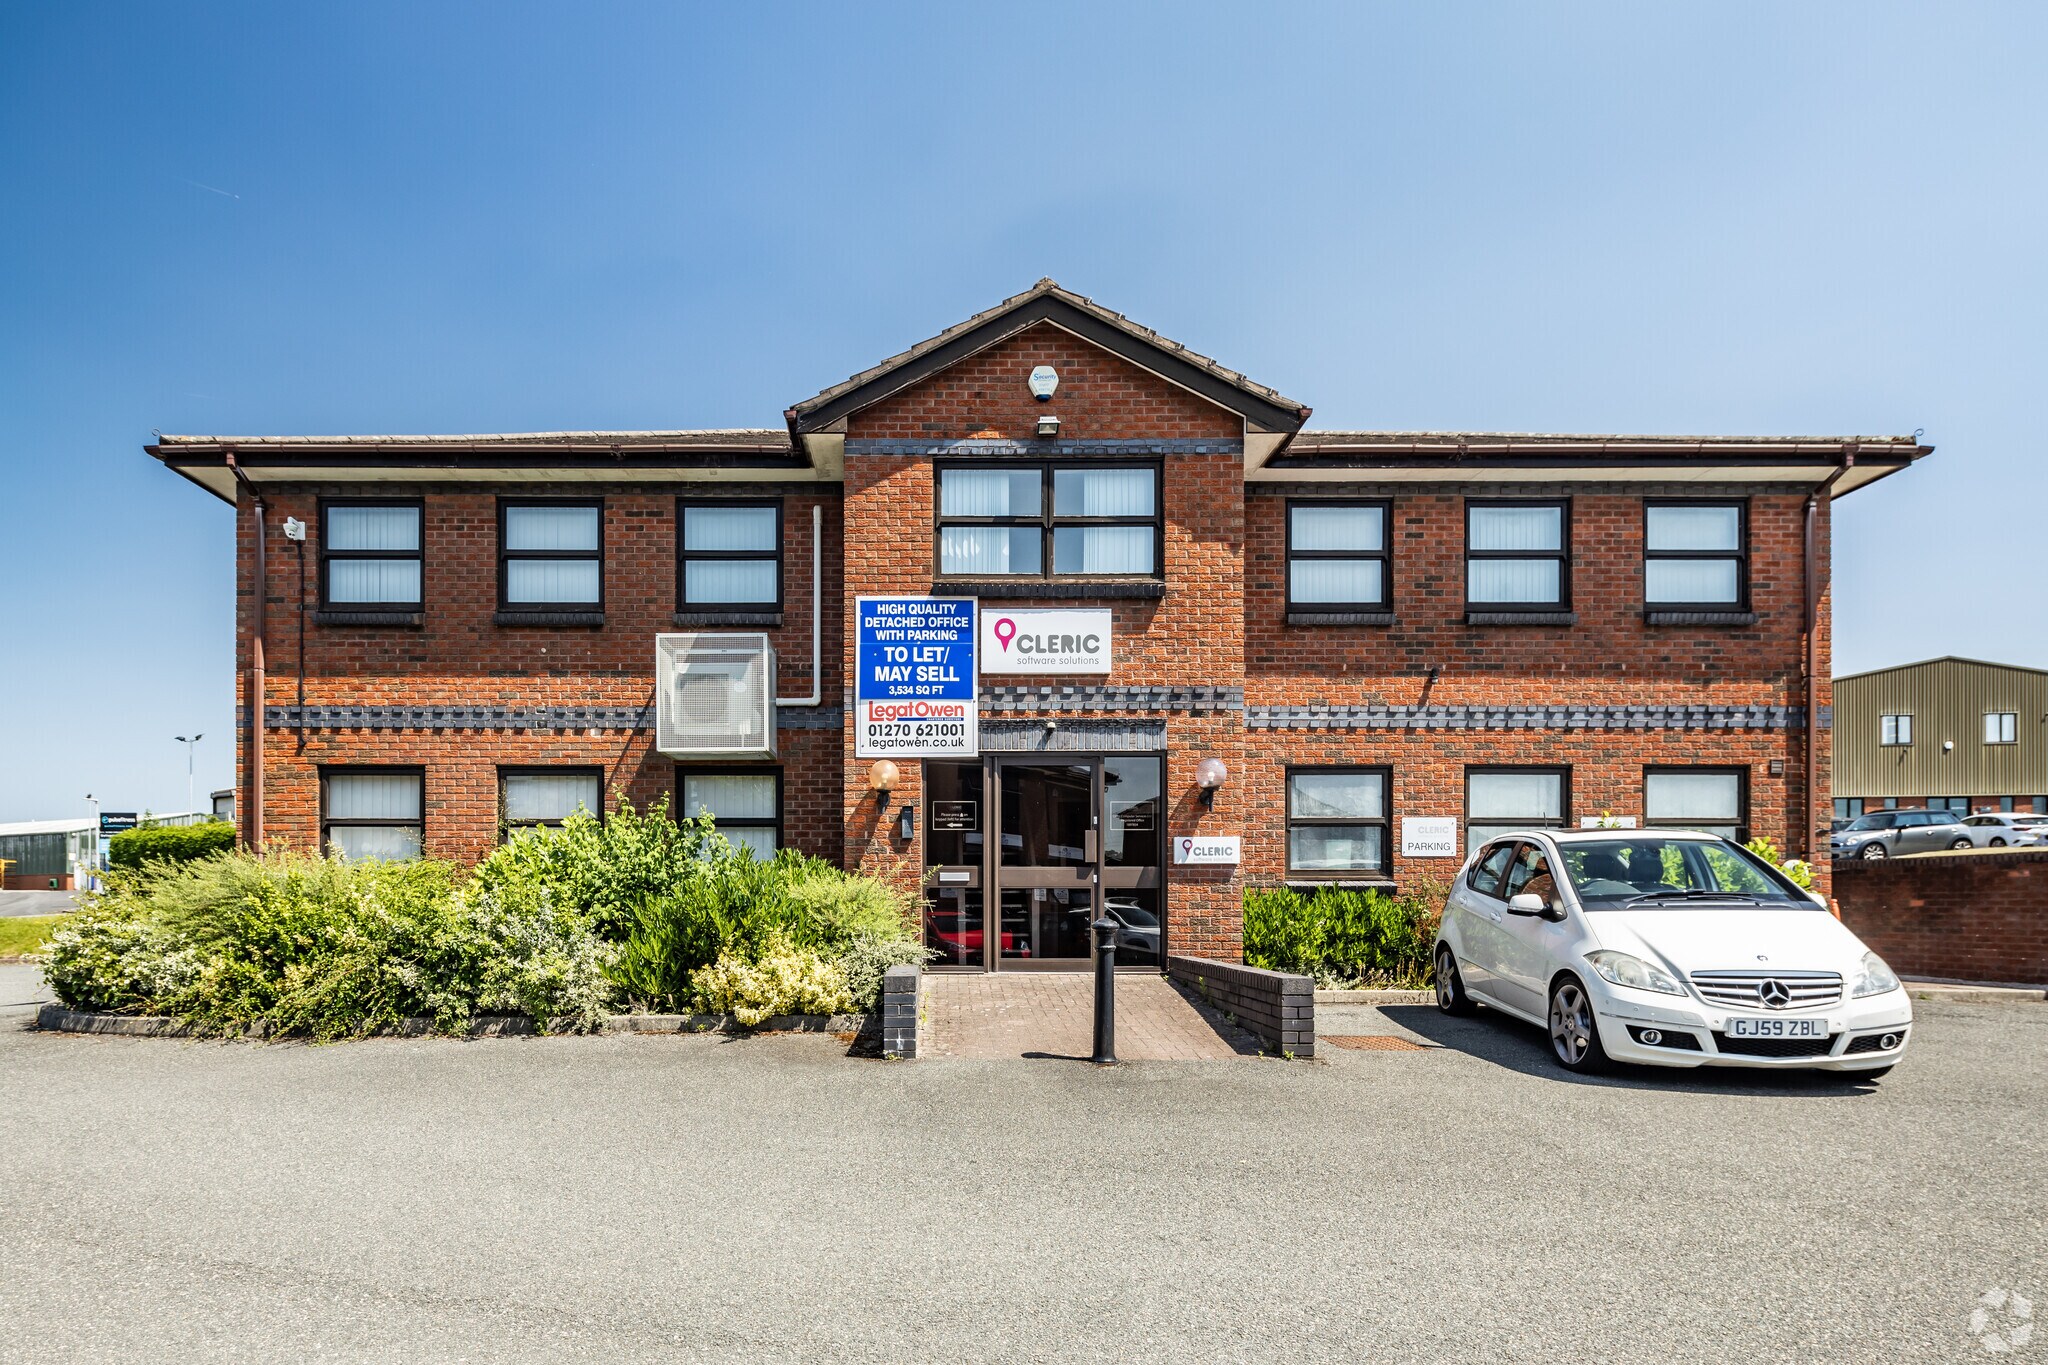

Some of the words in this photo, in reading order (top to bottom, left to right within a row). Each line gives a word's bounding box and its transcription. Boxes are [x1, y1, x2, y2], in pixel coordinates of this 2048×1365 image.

[877, 603, 906, 614] HIGH
[908, 603, 957, 615] QUALITY
[865, 617, 926, 628] DETACHED
[928, 617, 969, 628] OFFICE
[875, 629, 905, 640] WITH
[907, 629, 958, 641] PARKING
[1016, 634, 1100, 654] CLERIC
[883, 646, 909, 663] TO
[913, 646, 950, 664] LET/
[1017, 655, 1056, 665] software
[1059, 655, 1100, 665] solutions
[874, 665, 912, 682] MAY
[916, 665, 960, 682] SELL
[888, 685, 914, 696] 3,534
[916, 685, 930, 695] SQ
[932, 685, 944, 695] FT
[868, 723, 911, 737] 01270
[915, 723, 965, 737] 621001
[868, 737, 965, 750] legatowen.co.uk
[1418, 826, 1449, 834] CLERIC
[1193, 846, 1233, 856] CLERIC
[1407, 842, 1451, 851] PARKING
[1735, 1020, 1783, 1036] GJ59
[1788, 1020, 1822, 1036] ZBL
